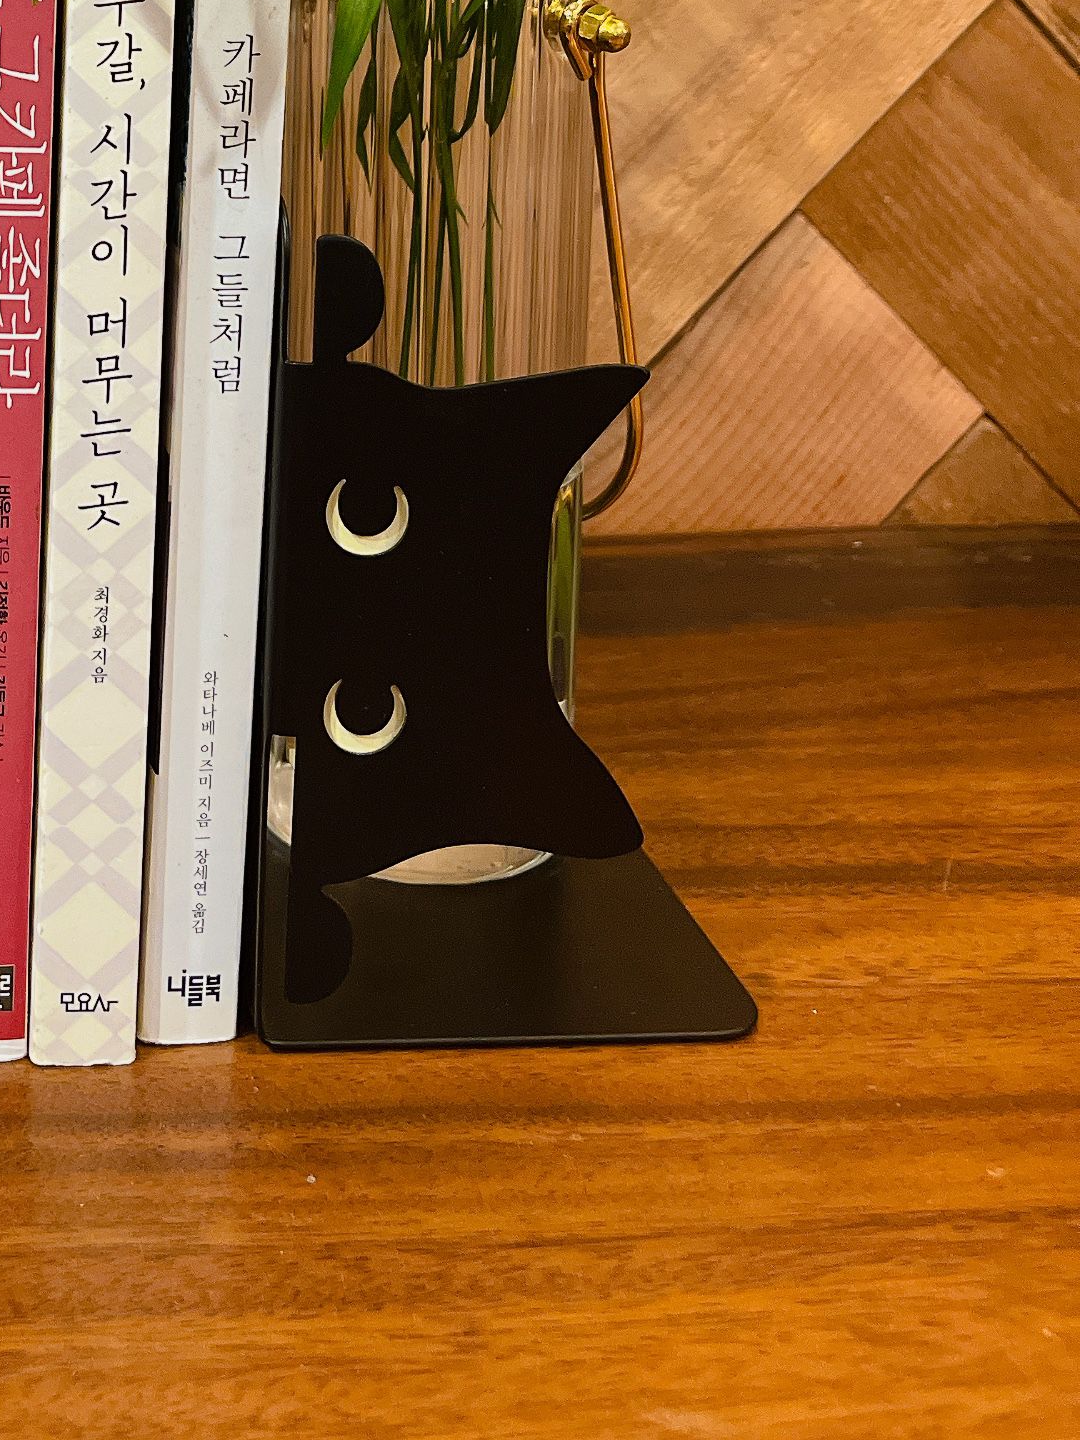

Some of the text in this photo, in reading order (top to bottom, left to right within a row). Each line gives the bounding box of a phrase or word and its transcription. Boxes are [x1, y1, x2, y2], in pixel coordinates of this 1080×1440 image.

[89, 112, 138, 276] 시간이
[209, 34, 261, 394] 카페라면 그들처럼
[80, 296, 133, 457] 머무는
[77, 481, 129, 531] 곳
[90, 586, 110, 685] 최경화 지음
[191, 670, 219, 935] 와타나베 이즈미 지음 장세연 옮김
[60, 992, 119, 1013] 모요사
[167, 968, 221, 1007] 나들북
